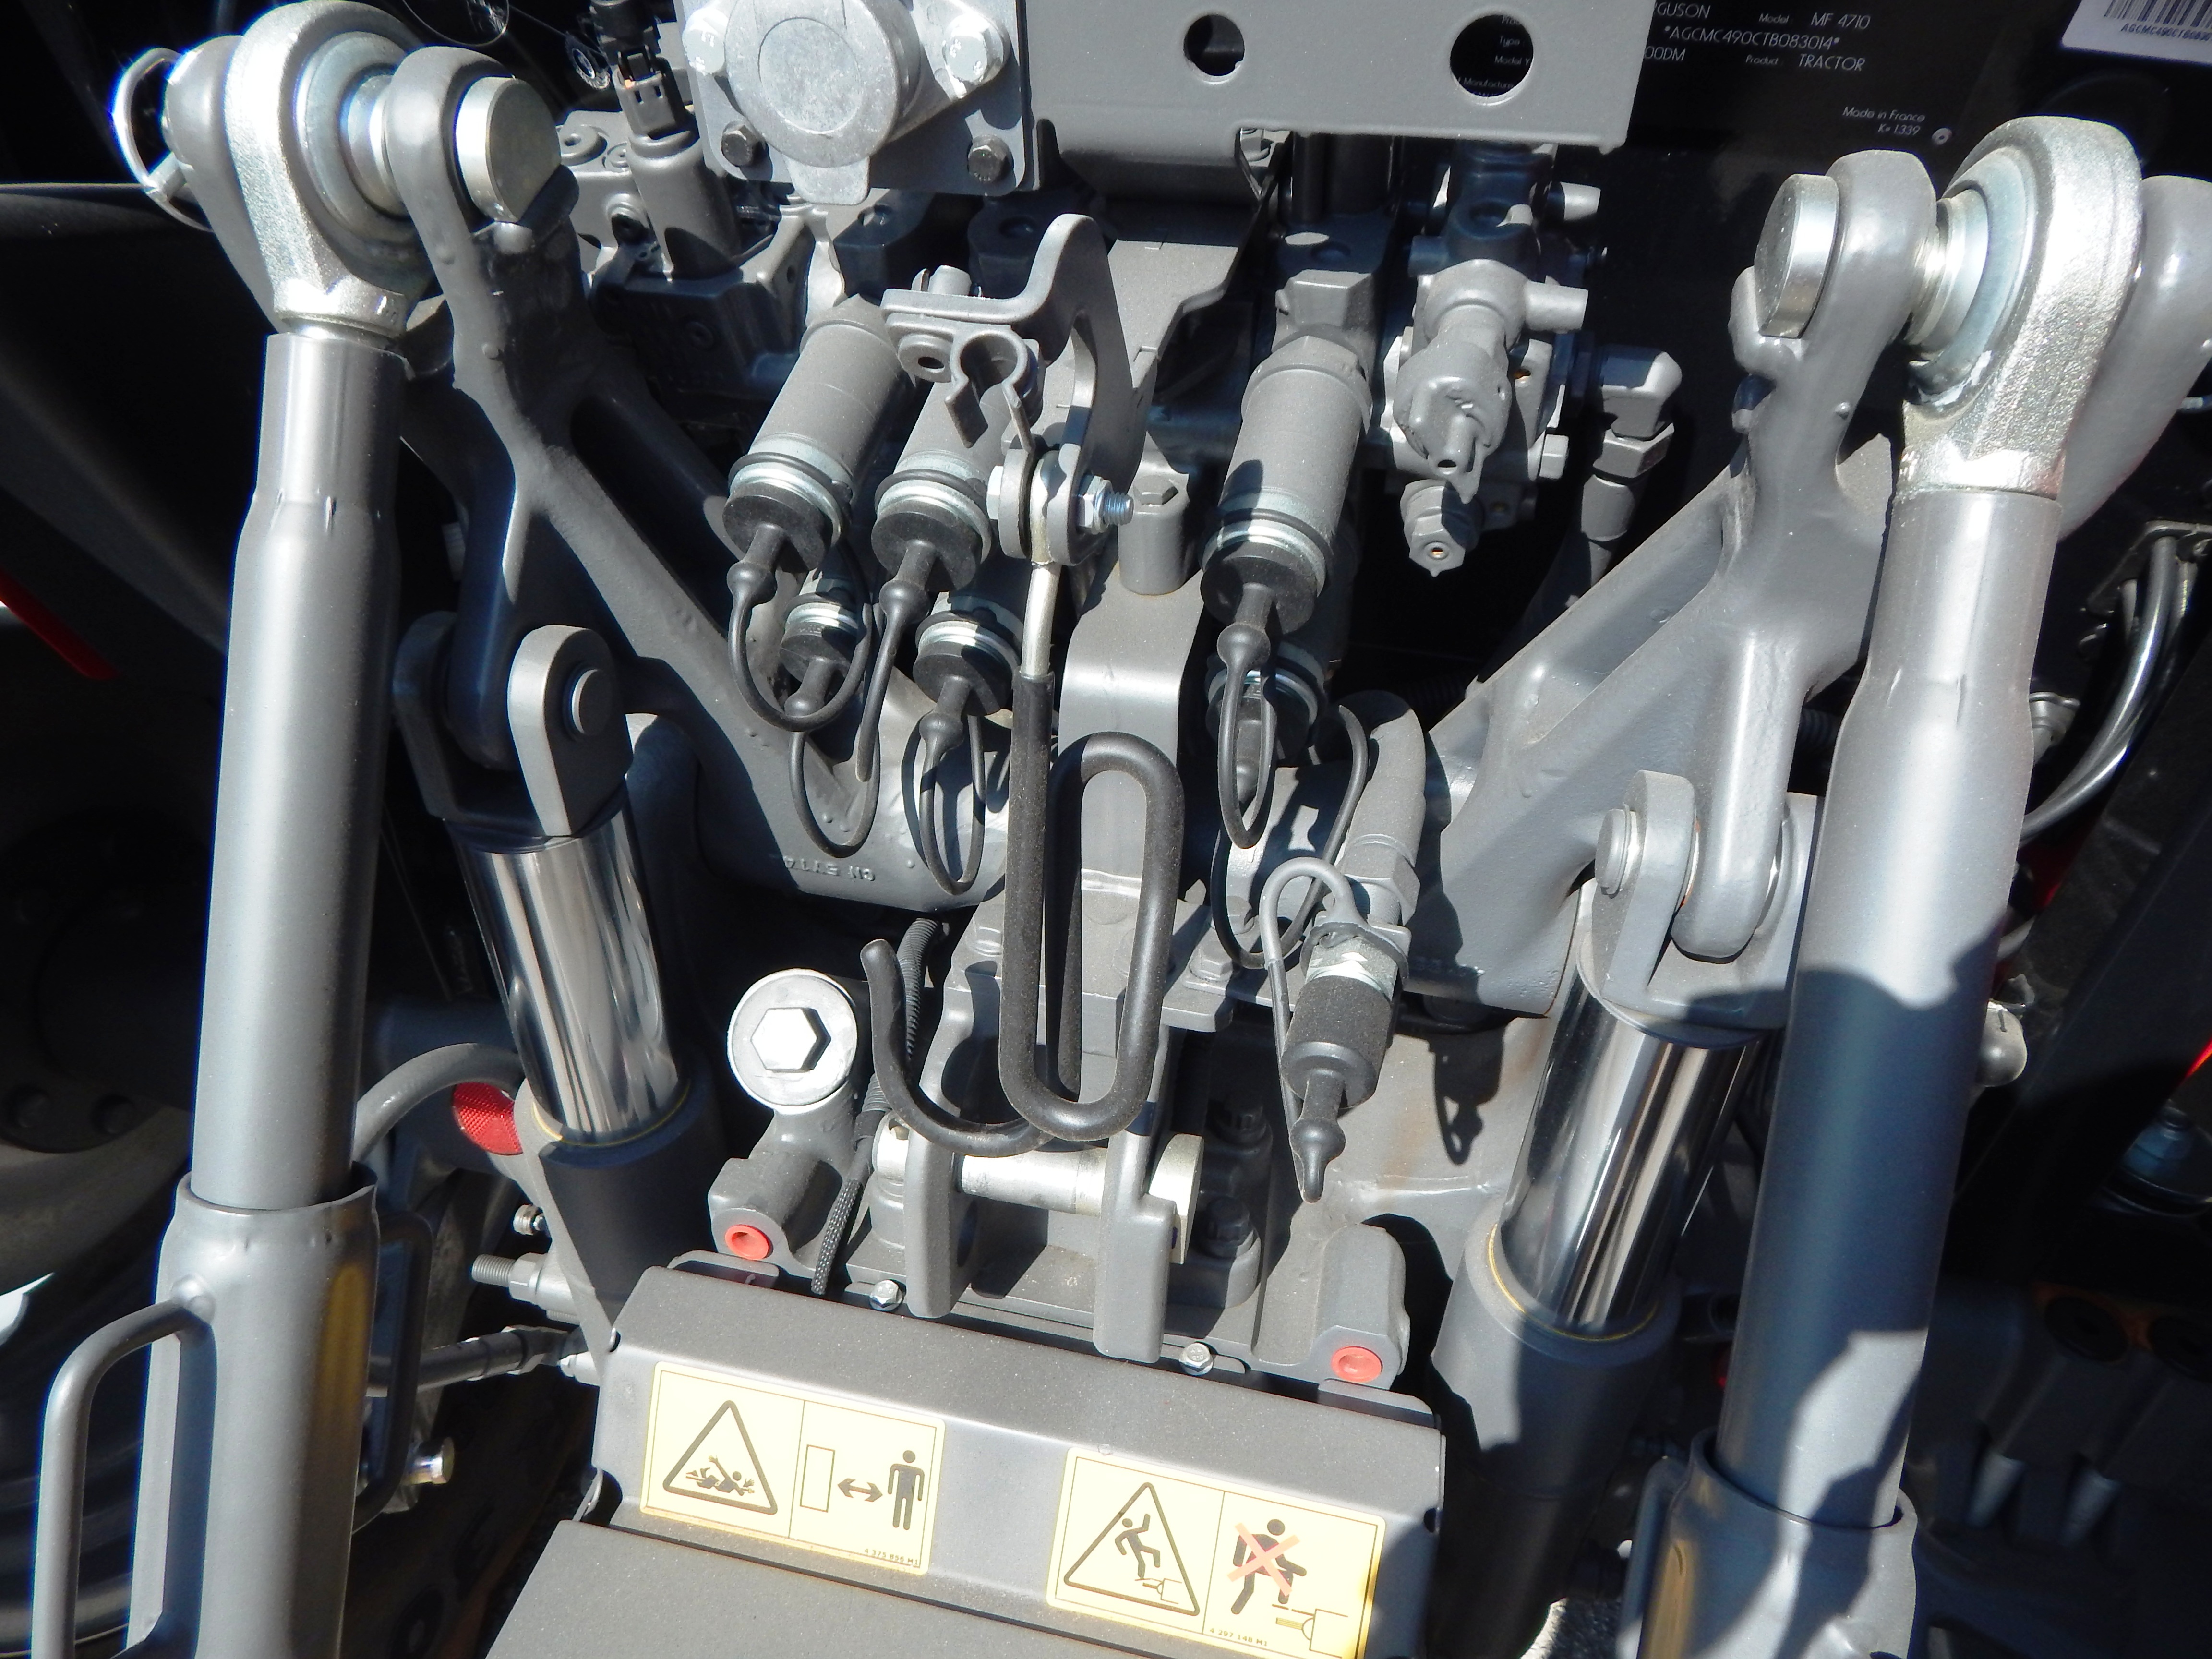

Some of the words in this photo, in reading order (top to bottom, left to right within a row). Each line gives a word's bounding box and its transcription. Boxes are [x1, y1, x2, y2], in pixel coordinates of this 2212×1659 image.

[1655, 2, 1711, 19] GUSON
[1758, 13, 1790, 24] Model
[1810, 12, 1834, 27] MF
[1838, 14, 1871, 30] 4710
[1745, 54, 1779, 65] Product
[1798, 53, 1865, 72] TRACTOR
[1842, 106, 1875, 119] Made
[1877, 110, 1887, 120] in
[1888, 109, 1925, 123] France
[872, 1550, 887, 1558] 375
[1218, 1629, 1234, 1637] 297
